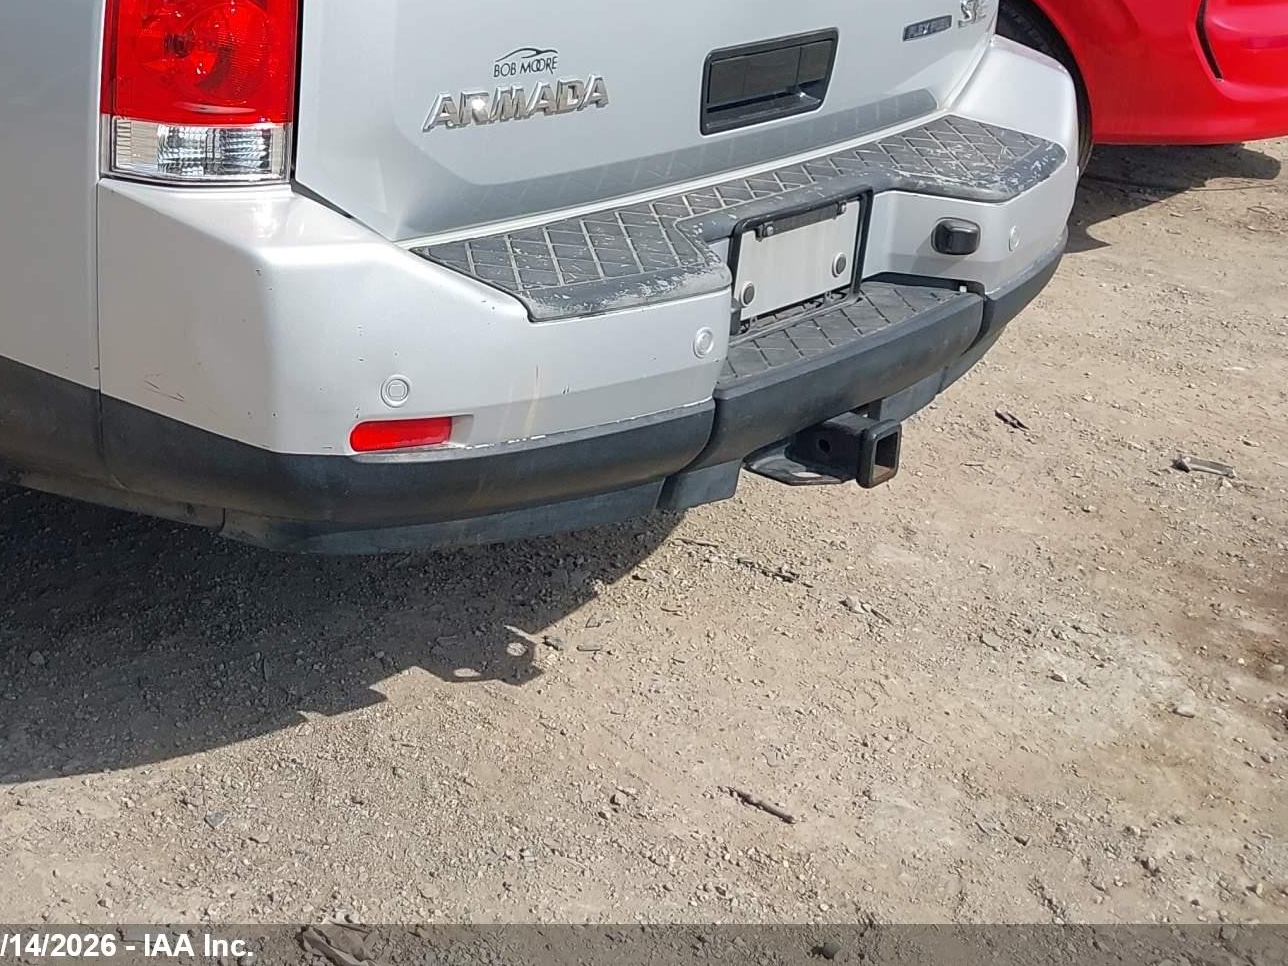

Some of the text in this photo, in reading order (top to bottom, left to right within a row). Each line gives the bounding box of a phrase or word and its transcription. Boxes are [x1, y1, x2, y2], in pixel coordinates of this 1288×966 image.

[493, 57, 558, 77] BOB MOORE
[422, 74, 609, 133] ARMADA
